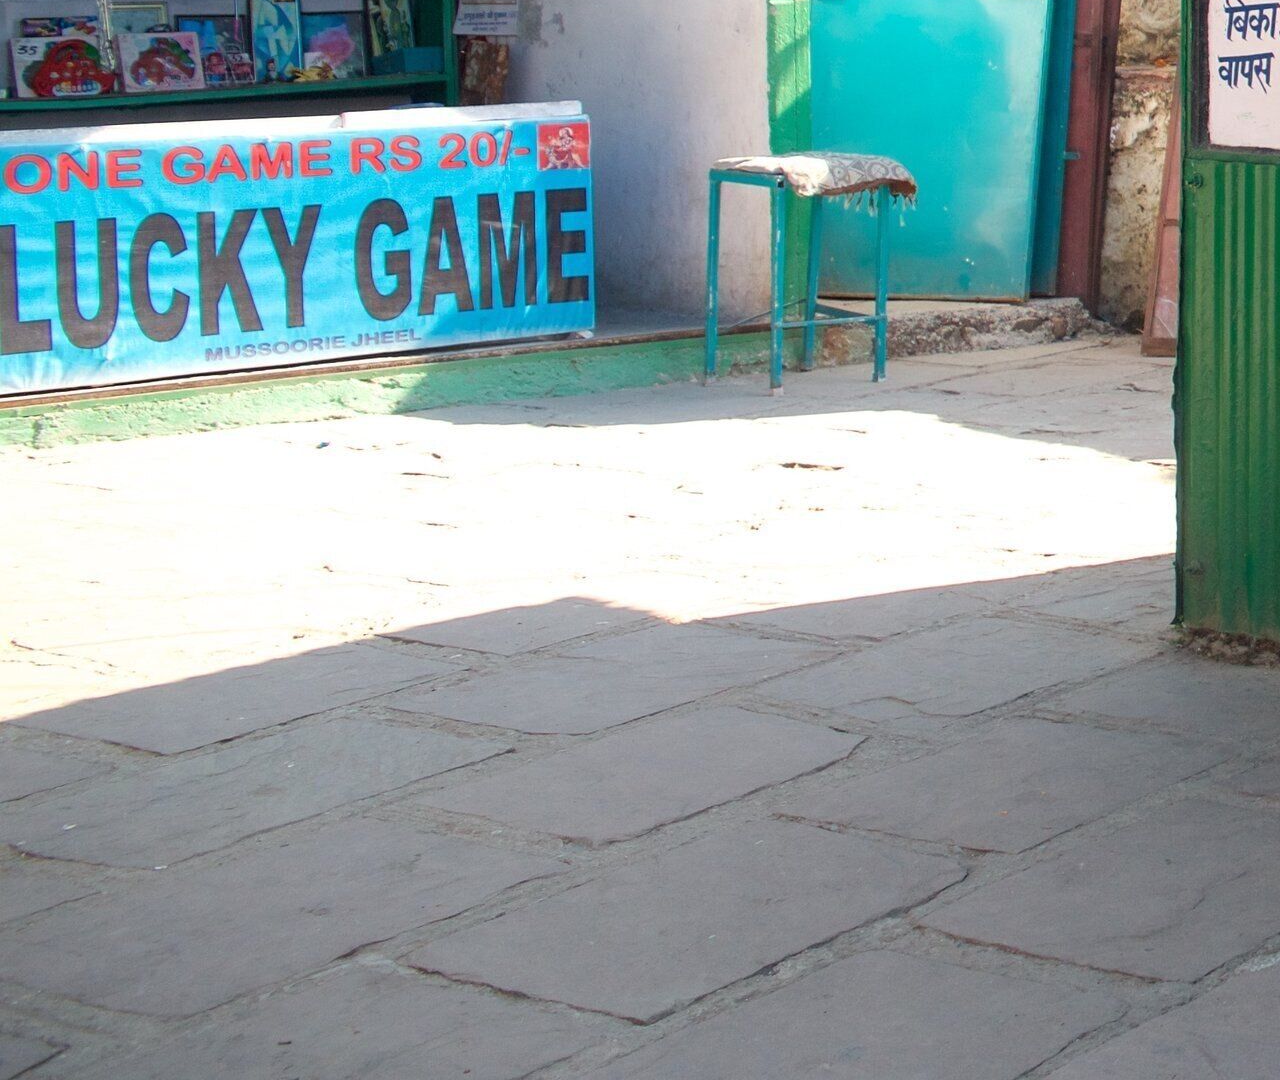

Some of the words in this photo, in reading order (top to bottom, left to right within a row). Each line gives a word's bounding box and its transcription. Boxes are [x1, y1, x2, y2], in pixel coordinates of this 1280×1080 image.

[17, 44, 37, 56] 35
[1218, 51, 1275, 94] वापस
[3, 146, 143, 193] ONE
[161, 138, 334, 184] GAME
[349, 134, 423, 175] RS
[0, 203, 323, 355] LUCKY
[354, 186, 589, 322] GAME
[204, 336, 346, 363] MUSSOORIE
[349, 328, 422, 351] JHEEL
